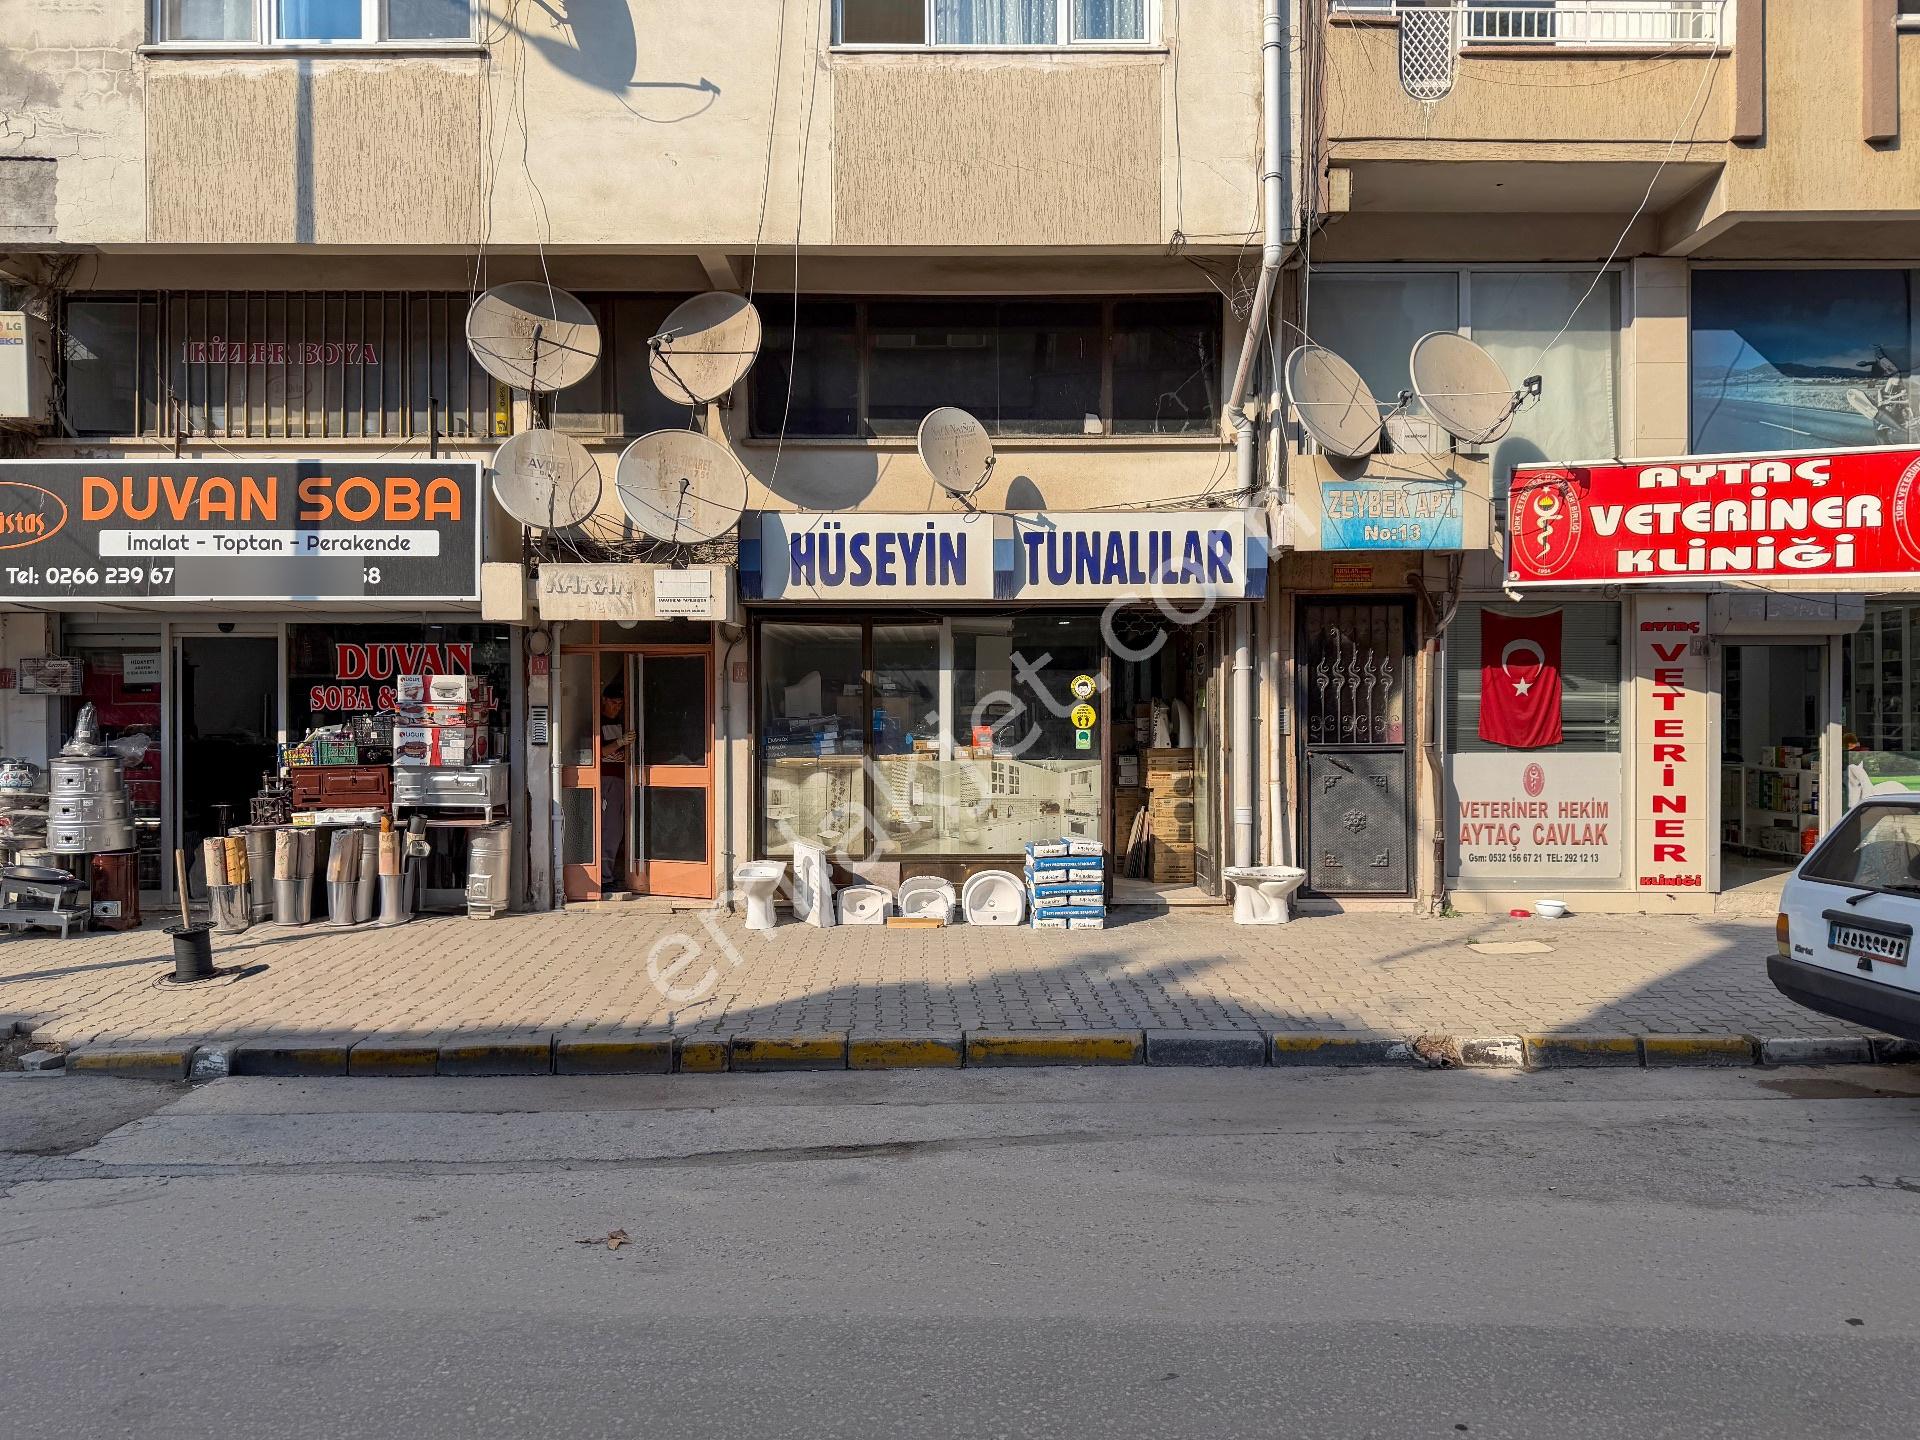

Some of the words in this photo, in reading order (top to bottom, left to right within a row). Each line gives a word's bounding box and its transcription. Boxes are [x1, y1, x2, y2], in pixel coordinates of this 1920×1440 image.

[6, 322, 22, 330] LG
[298, 342, 379, 365] BOYA
[1638, 459, 1831, 489] AYTAÇ
[82, 476, 278, 522] DUVAN
[297, 476, 462, 522] SOBA
[1327, 489, 1410, 519] ZEYBEK
[1415, 490, 1458, 519] APT.
[1588, 487, 1883, 537] VETERİNER
[127, 533, 190, 552] İmalat
[214, 534, 283, 555] Toptan
[307, 533, 411, 552] Perakende
[1364, 523, 1422, 541] No:13
[790, 521, 967, 587] HÜSEYİN
[1023, 529, 1234, 586] TUNALILAR
[1617, 533, 1855, 573] KLİNİĞİ
[6, 567, 39, 585] Tel:
[46, 567, 99, 585] 0266
[105, 567, 143, 585] 239
[150, 567, 175, 585] 67
[1640, 620, 1701, 634] AYTAÇ
[336, 642, 474, 681] DUVAN
[310, 685, 373, 711] SOBA
[1651, 643, 1689, 863] VETERİNER
[1459, 797, 1549, 819] VETERİNER
[1558, 797, 1609, 819] HEKİM
[1459, 823, 1521, 852] AYTAÇ
[1532, 823, 1608, 846] CAVLAK
[1468, 854, 1487, 863] Gsm:
[1488, 853, 1507, 863] 0532
[1508, 853, 1521, 863] 156
[1523, 853, 1532, 863] 67
[1533, 853, 1543, 863] 21
[1547, 853, 1563, 863] TEL:
[1564, 853, 1578, 863] 292
[1580, 853, 1588, 863] 12
[1590, 853, 1599, 863] 13
[1640, 873, 1702, 887] KLİNİĞİ
